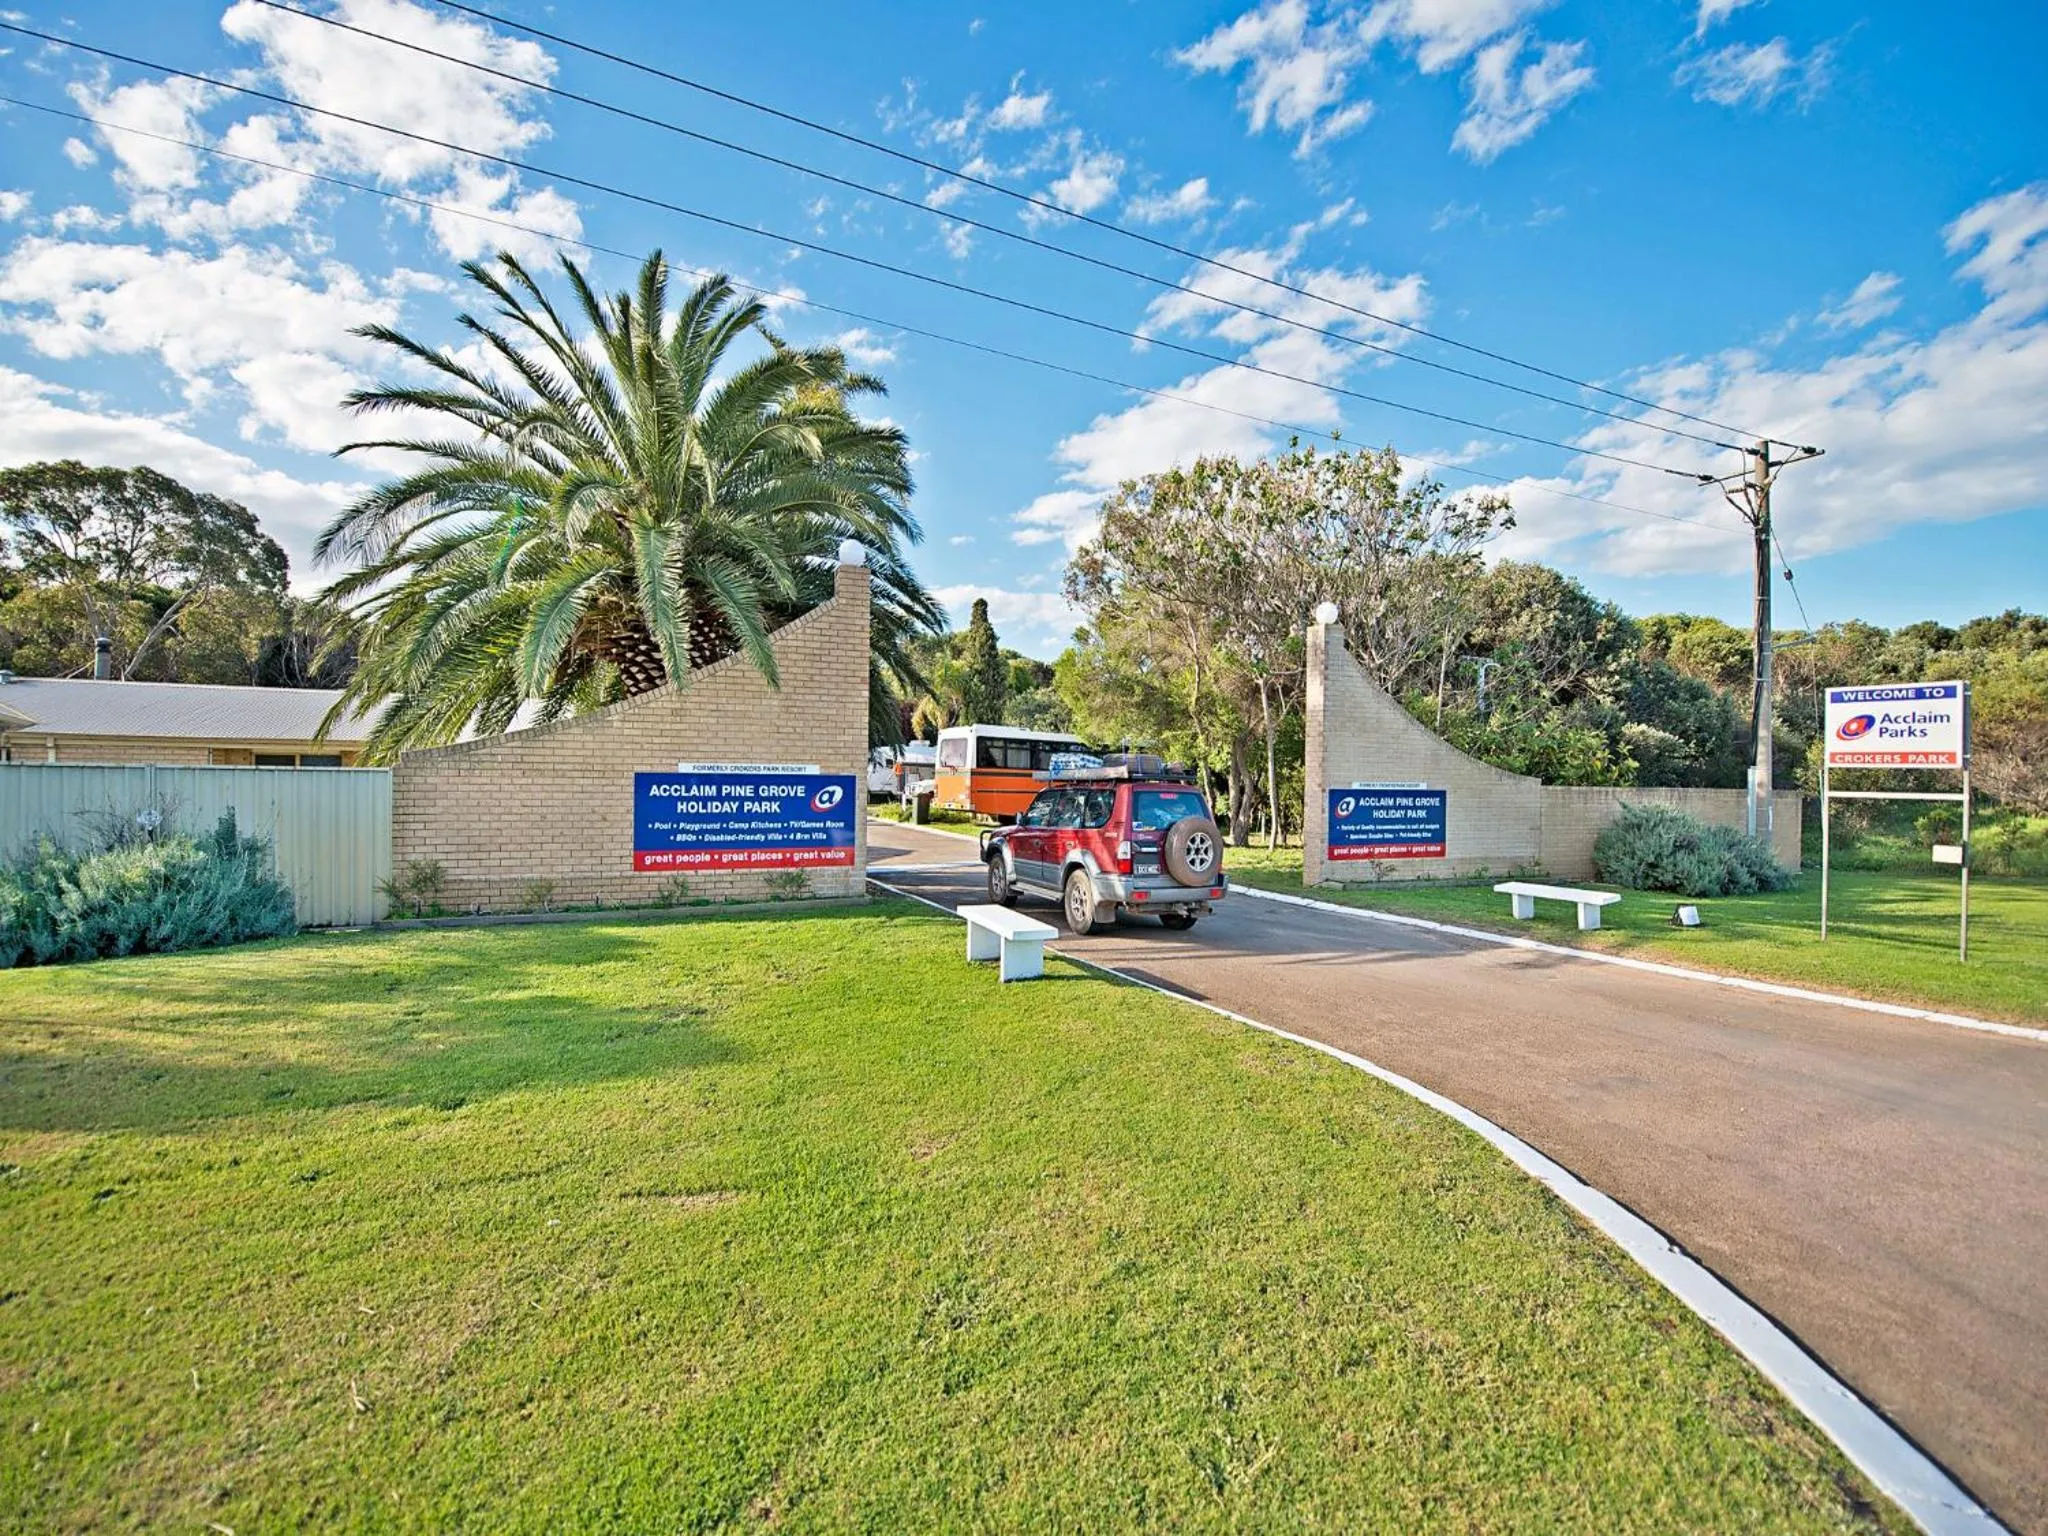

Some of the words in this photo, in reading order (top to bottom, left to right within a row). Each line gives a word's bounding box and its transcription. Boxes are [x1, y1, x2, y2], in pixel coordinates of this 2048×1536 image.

[1842, 689, 1916, 701] WELCOME
[1923, 688, 1945, 697] TO
[1879, 711, 1951, 724] Acclaim
[1879, 726, 1928, 738] Parks
[1835, 754, 1901, 763] CROKERS
[1908, 754, 1949, 763] PARK
[649, 784, 717, 797] ACCLAIM
[722, 785, 755, 797] PINE
[758, 785, 805, 797] GROVE
[677, 801, 738, 814] HOLIDAY
[744, 801, 780, 813] PARK
[1359, 797, 1395, 807] ACCLAIM
[1396, 797, 1413, 806] PINE
[1415, 798, 1440, 807] GROVE
[1372, 810, 1405, 818] HOLIDAY
[1407, 810, 1427, 818] PARK
[654, 822, 671, 830] Pool
[679, 822, 720, 831] Playground
[728, 822, 749, 830] Camp
[1334, 848, 1350, 856] great
[1350, 846, 1369, 855] people
[1374, 846, 1389, 854] great
[1412, 844, 1426, 853] great
[644, 854, 673, 865] great
[676, 853, 711, 864] people
[722, 852, 748, 862] great
[751, 851, 783, 862] places
[793, 850, 820, 861] great
[821, 850, 845, 859] value
